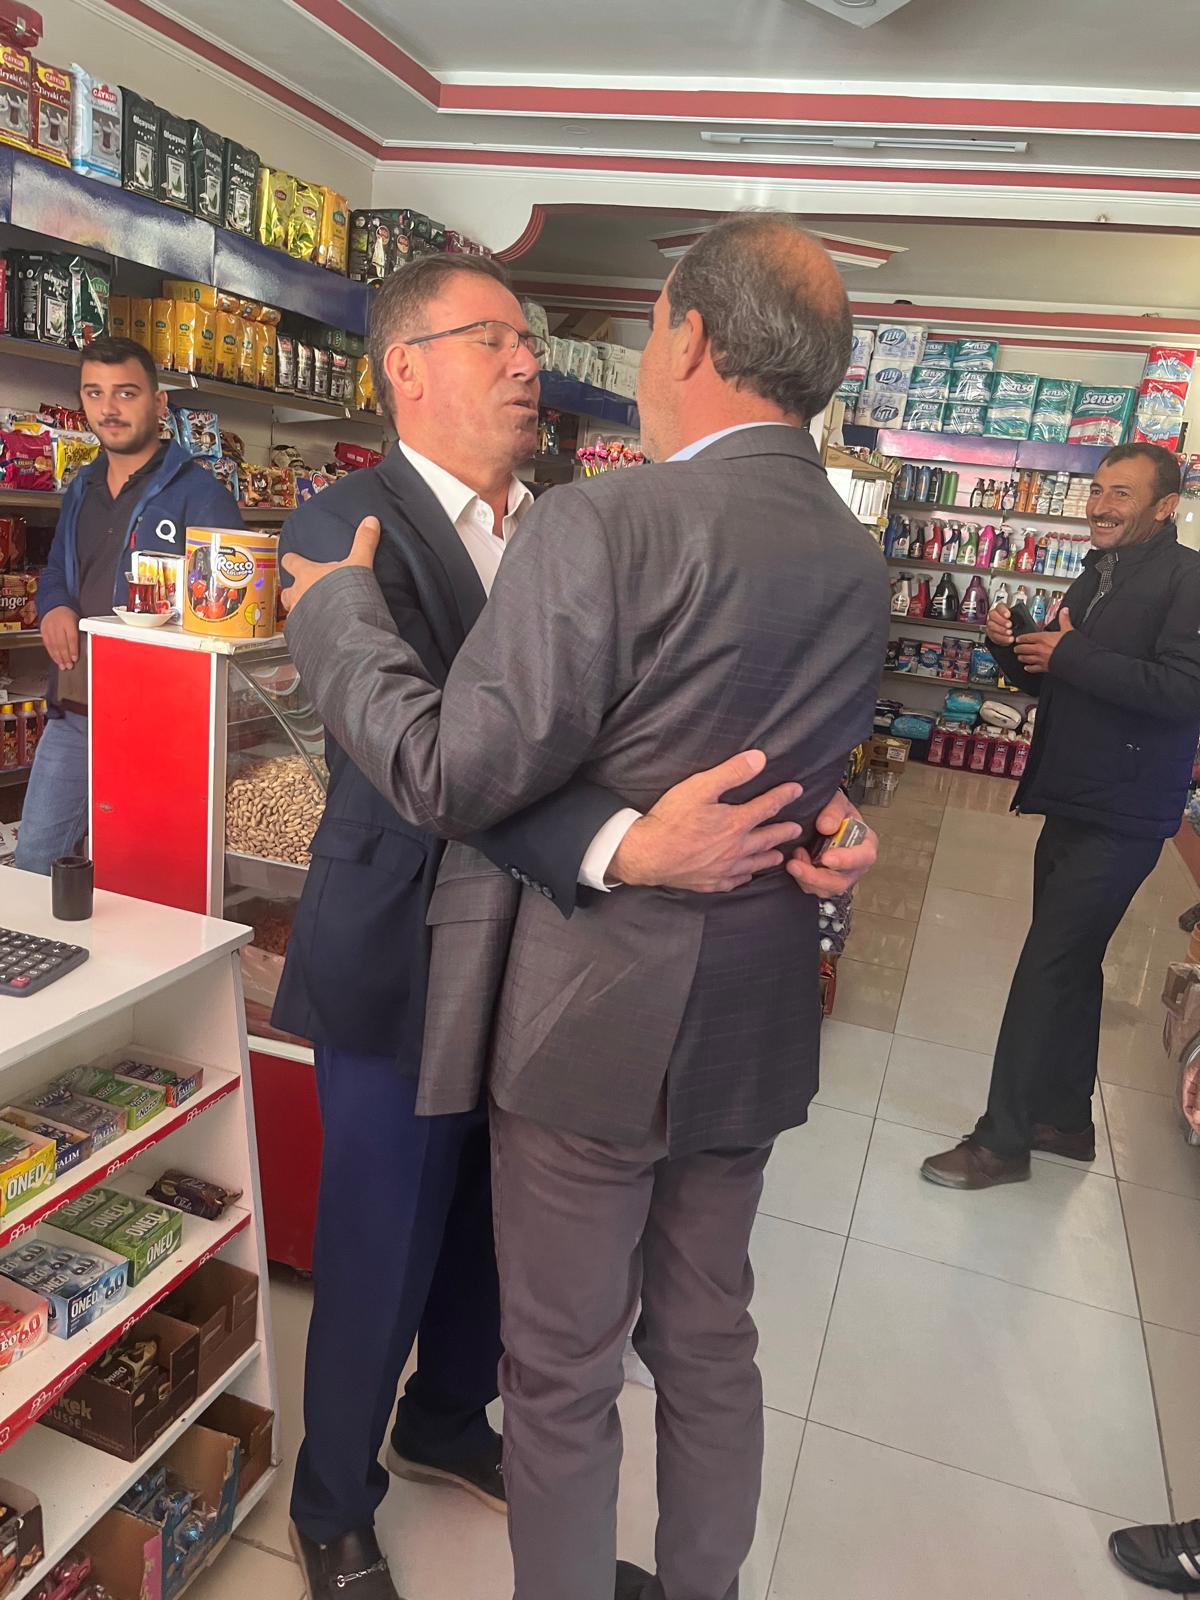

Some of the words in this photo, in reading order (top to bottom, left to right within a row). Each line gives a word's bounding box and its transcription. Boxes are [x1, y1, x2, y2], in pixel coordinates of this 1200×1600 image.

[881, 330, 904, 346] Lily
[879, 370, 901, 385] Lily
[1083, 390, 1125, 405] Senso
[217, 554, 254, 573] Rocco
[0, 595, 28, 610] nger
[7, 1162, 46, 1200] ONEO
[61, 1193, 98, 1216] ONEO
[91, 1204, 128, 1228] ONEO
[125, 1211, 161, 1237] ONEO
[147, 1230, 174, 1264] ONEO
[71, 1290, 98, 1318] ONEO
[0, 1332, 18, 1352] EO
